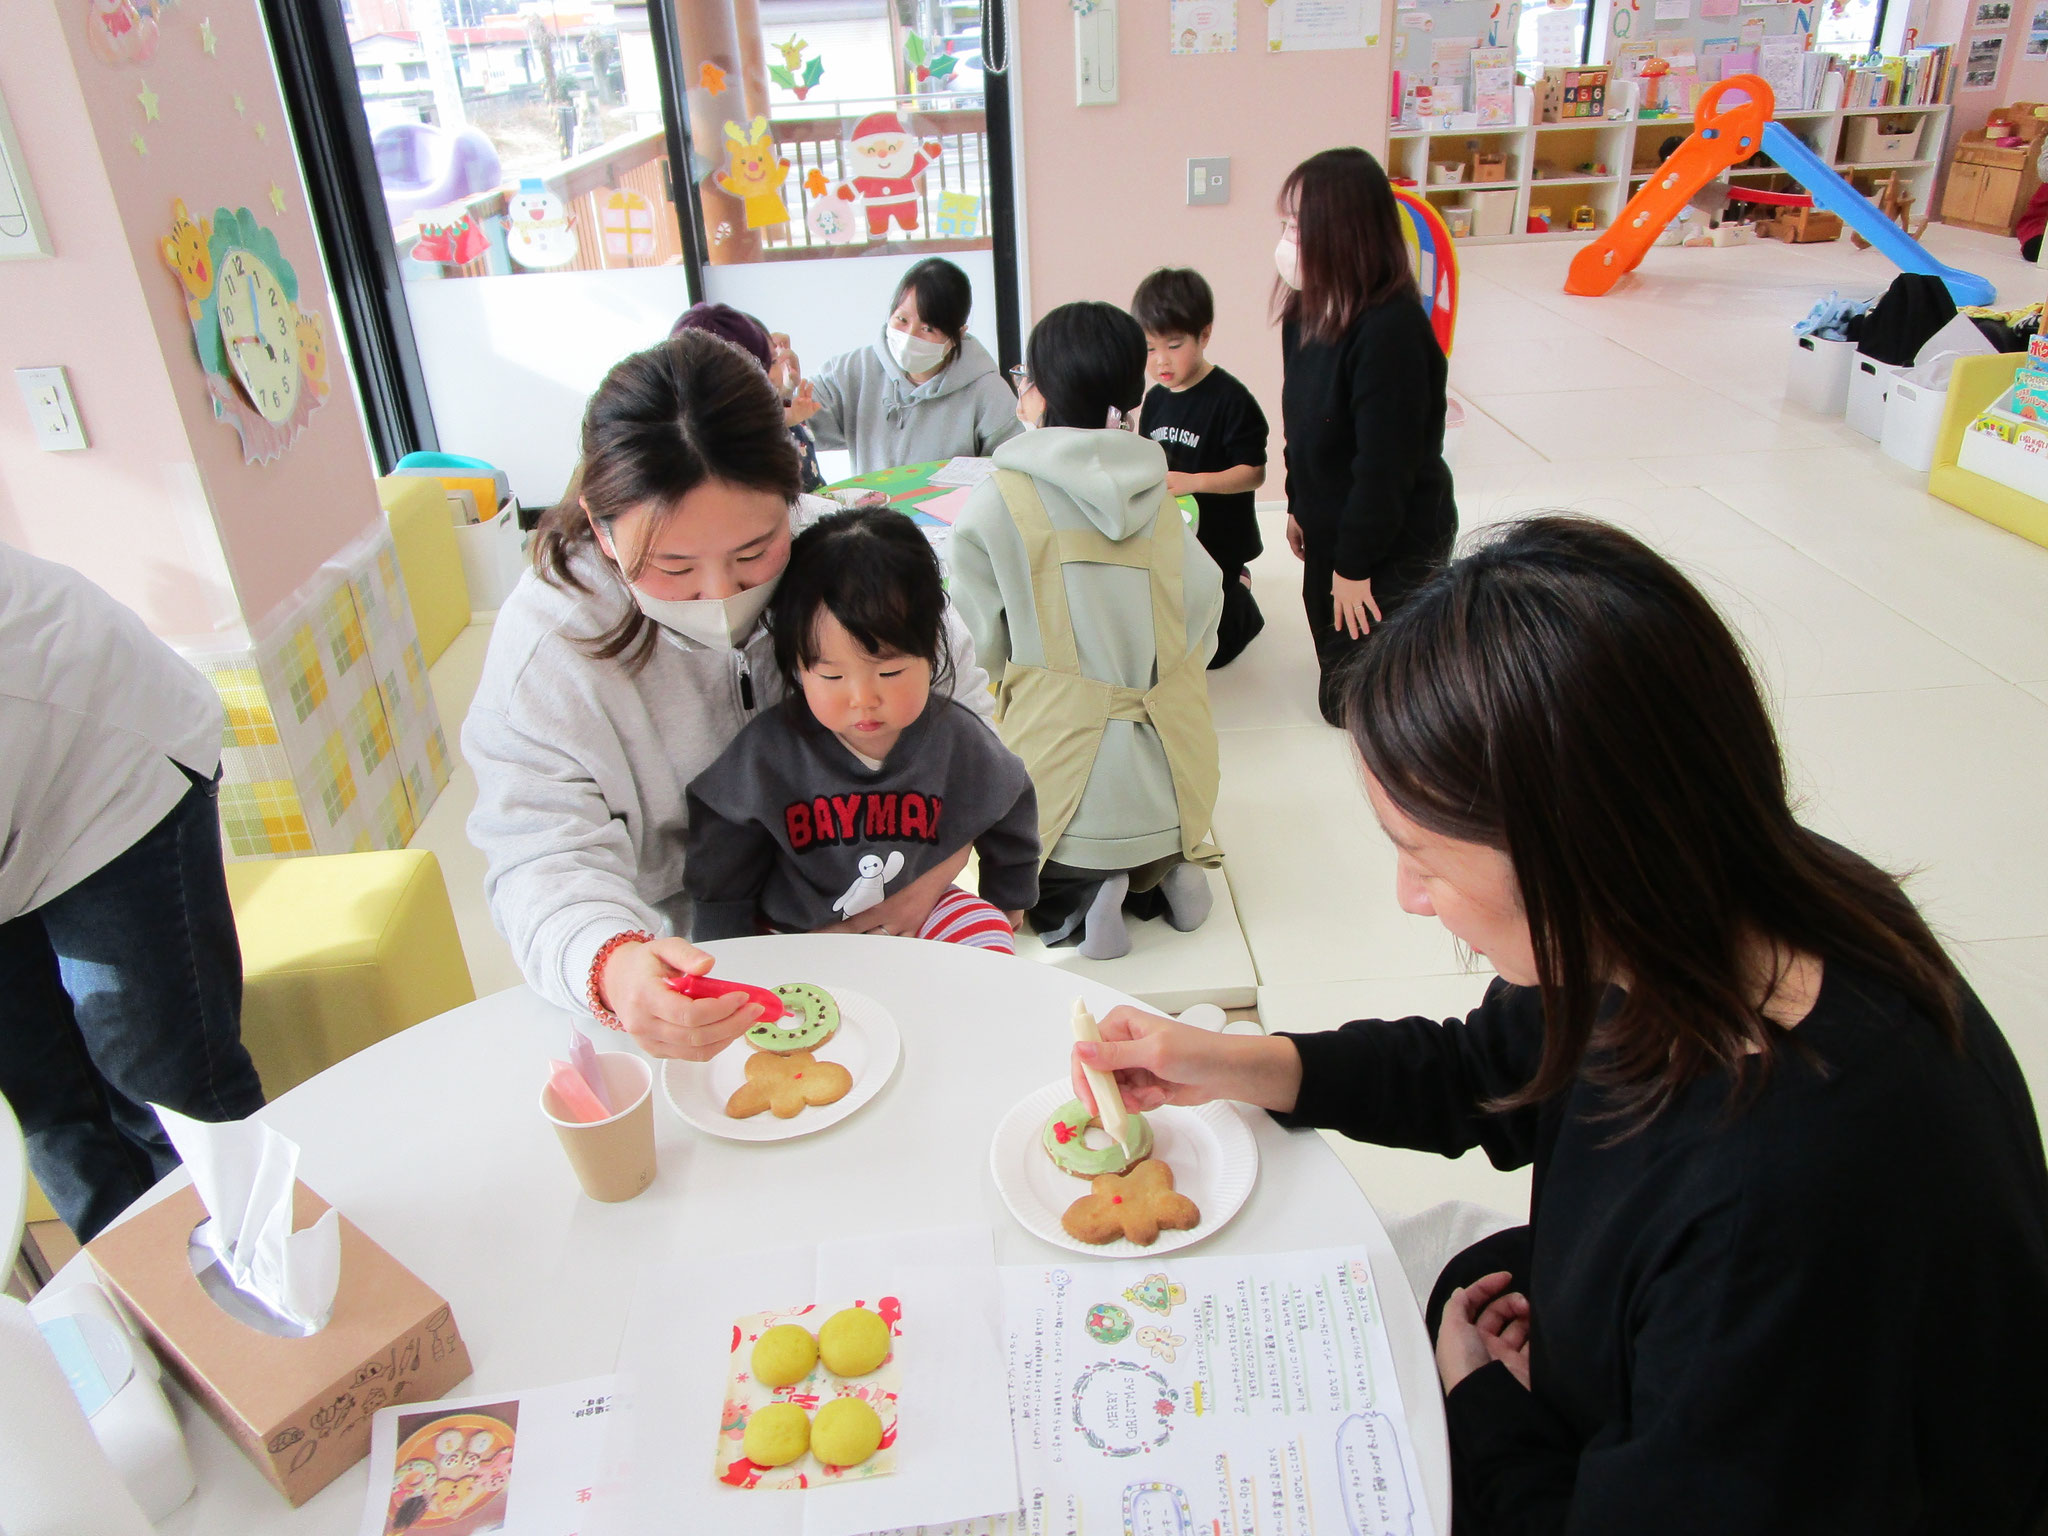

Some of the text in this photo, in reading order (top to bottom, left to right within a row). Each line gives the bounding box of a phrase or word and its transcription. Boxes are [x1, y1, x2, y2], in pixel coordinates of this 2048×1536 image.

[1792, 6, 1815, 34] N
[1567, 88, 1602, 101] 4 5 6
[1592, 102, 1600, 114] 9
[231, 255, 245, 276] 12
[225, 274, 236, 296] 11
[253, 270, 261, 289] 1
[268, 287, 277, 307] 2
[222, 306, 234, 327] 10
[278, 317, 287, 336] 3
[283, 348, 290, 365] 4
[282, 376, 290, 394] 5
[260, 389, 267, 408] 7
[272, 391, 281, 408] 6
[2019, 396, 2048, 413] アンパンマ
[785, 792, 943, 852] BAYMAX
[1106, 1390, 1119, 1429] MERRY
[1123, 1377, 1138, 1439] CHRISTMAS
